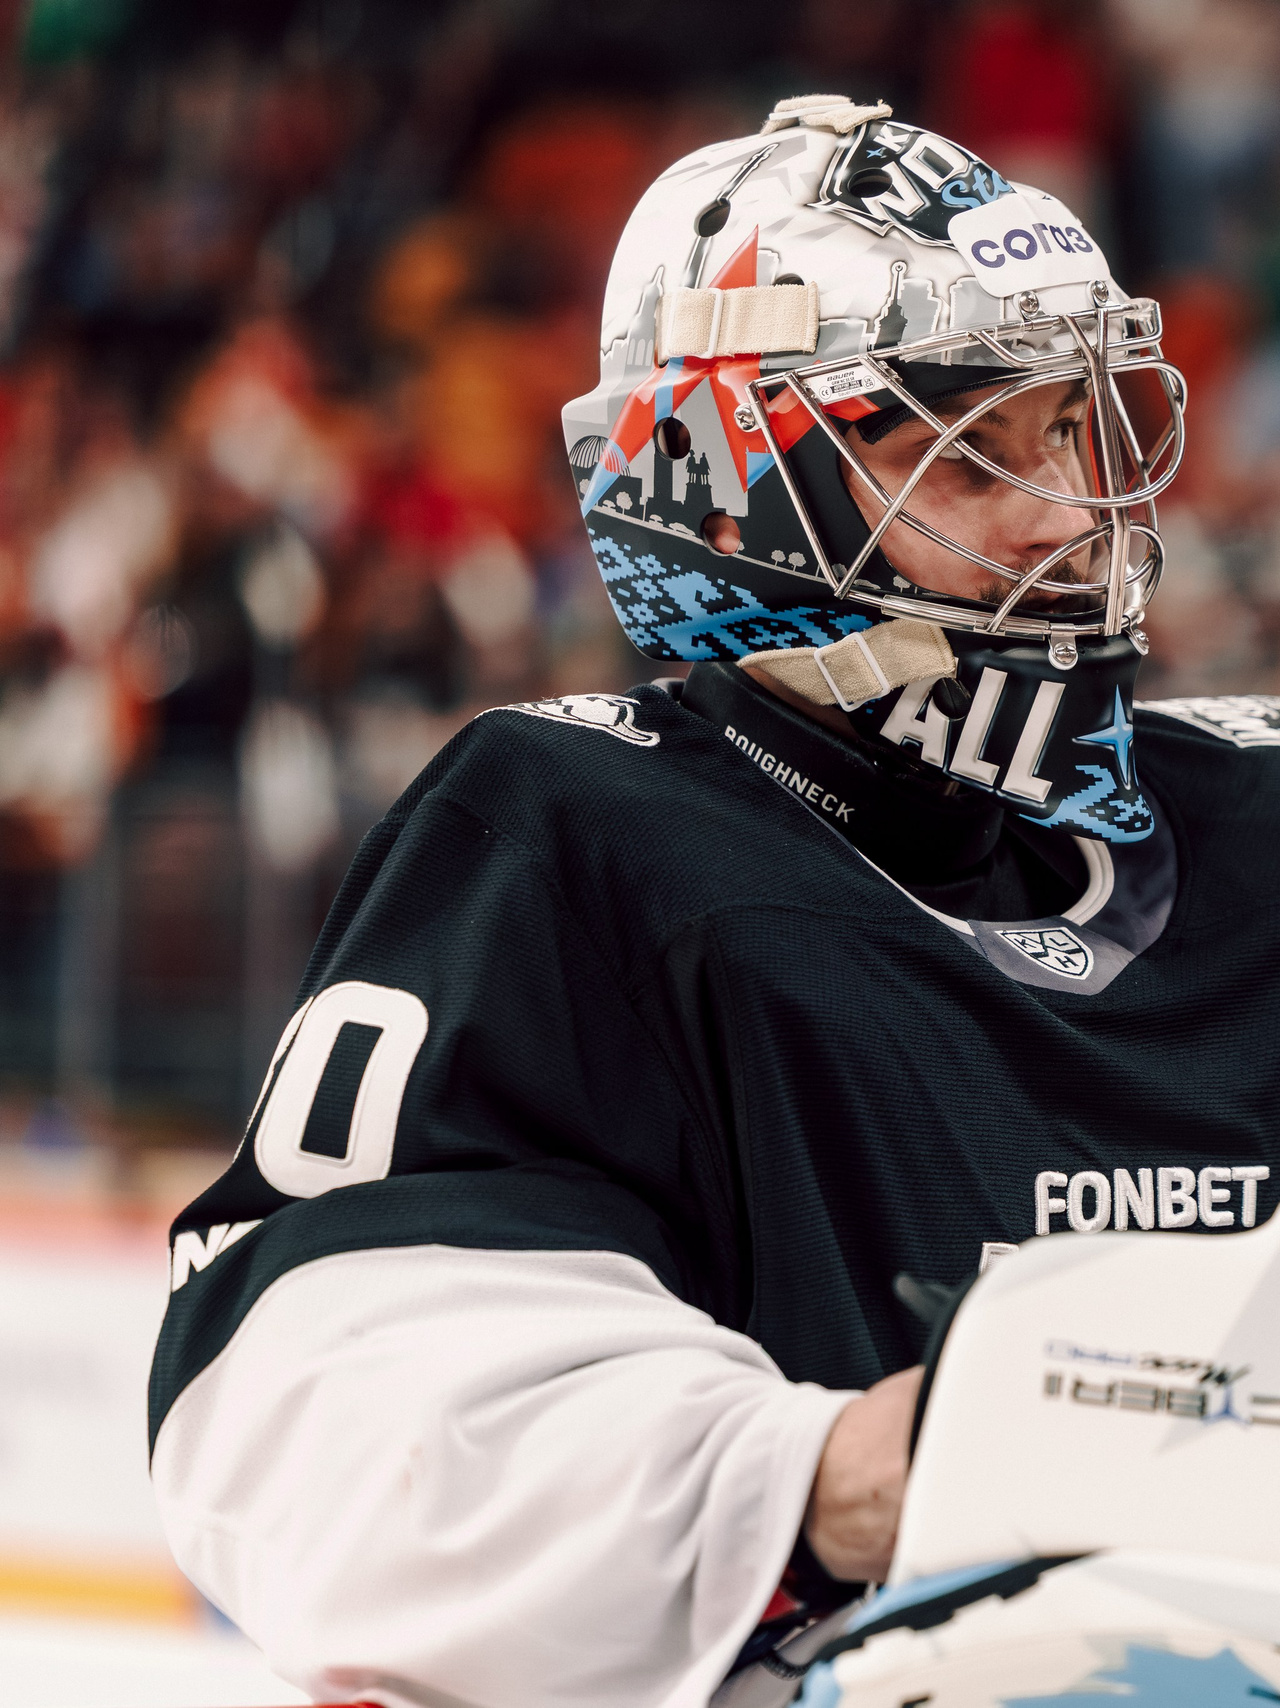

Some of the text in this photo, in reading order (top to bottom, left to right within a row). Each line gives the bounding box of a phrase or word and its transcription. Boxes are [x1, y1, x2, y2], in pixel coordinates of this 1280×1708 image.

[971, 222, 1094, 269] согаз
[880, 657, 1067, 803] ALL
[1034, 1166, 1270, 1235] FONBET
